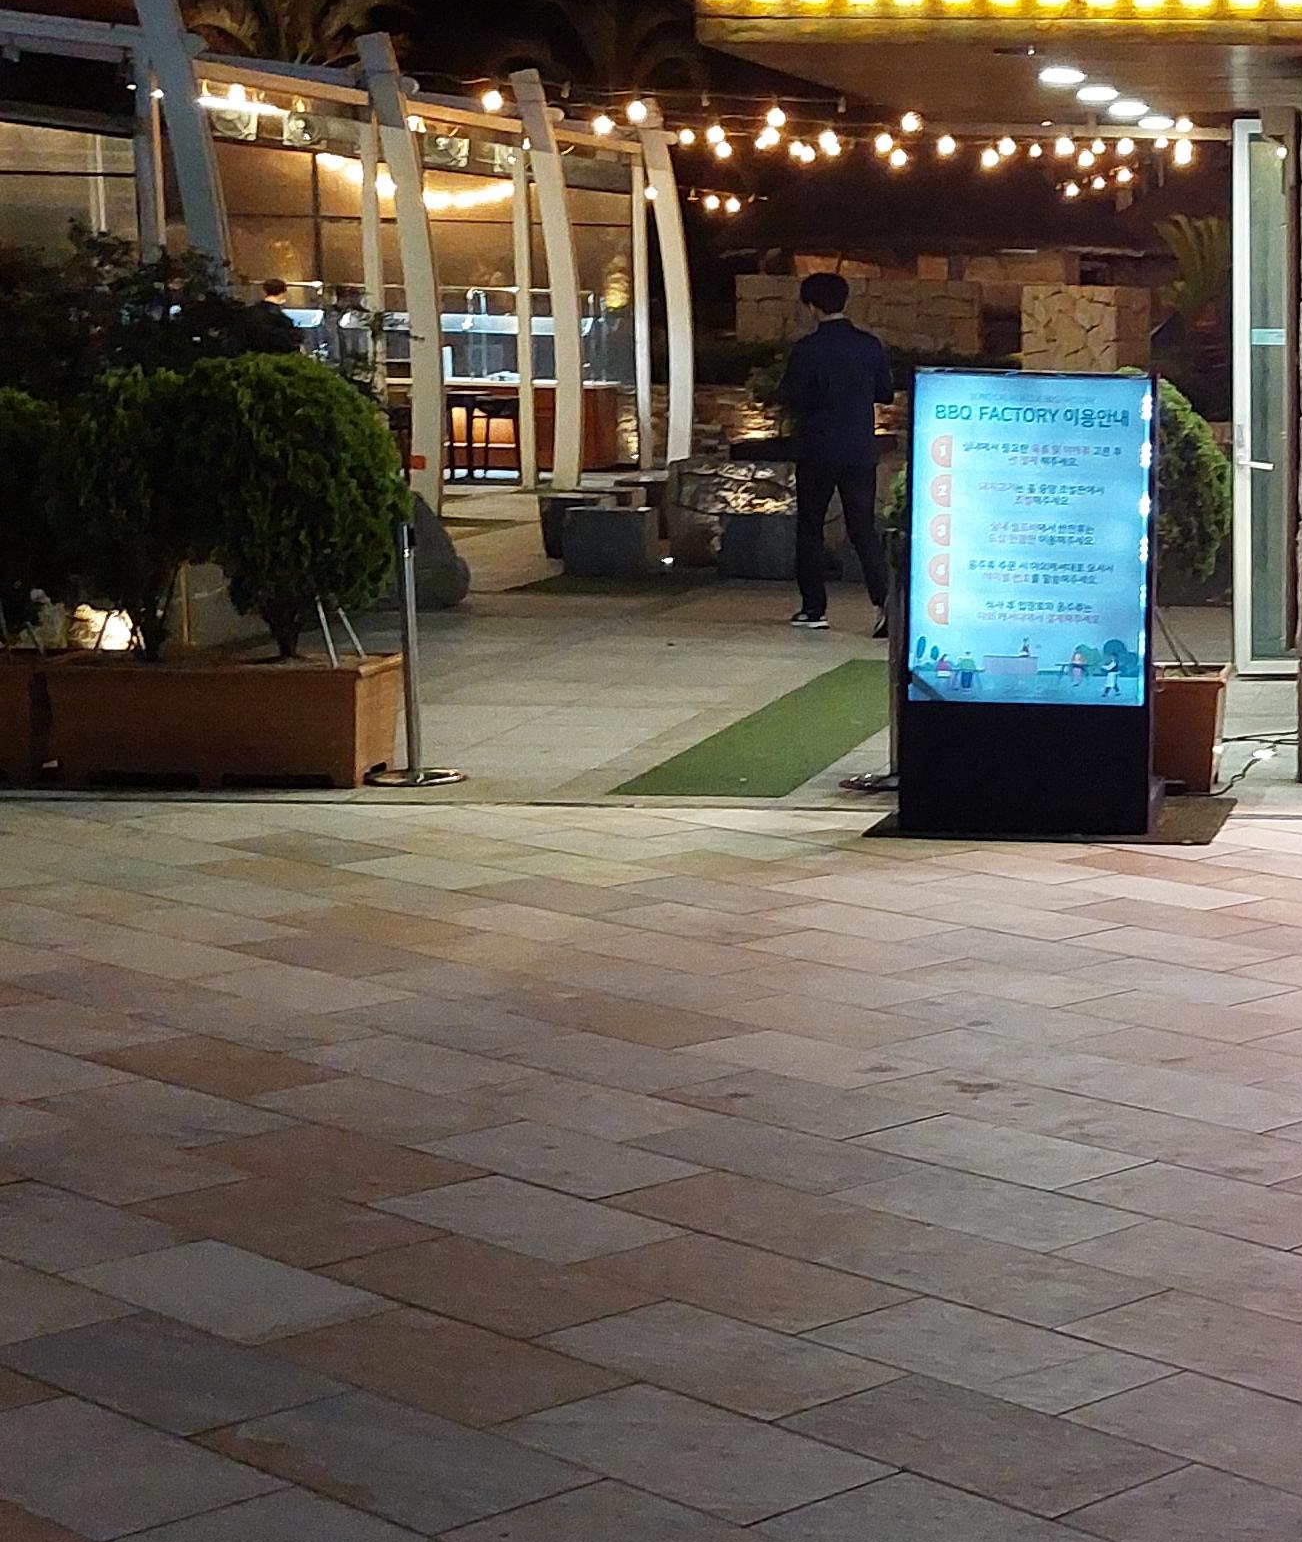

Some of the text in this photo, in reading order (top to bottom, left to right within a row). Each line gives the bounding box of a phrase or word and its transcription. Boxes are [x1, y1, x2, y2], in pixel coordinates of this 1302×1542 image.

[935, 404, 1130, 428] BBQ FACTORY 이용안내
